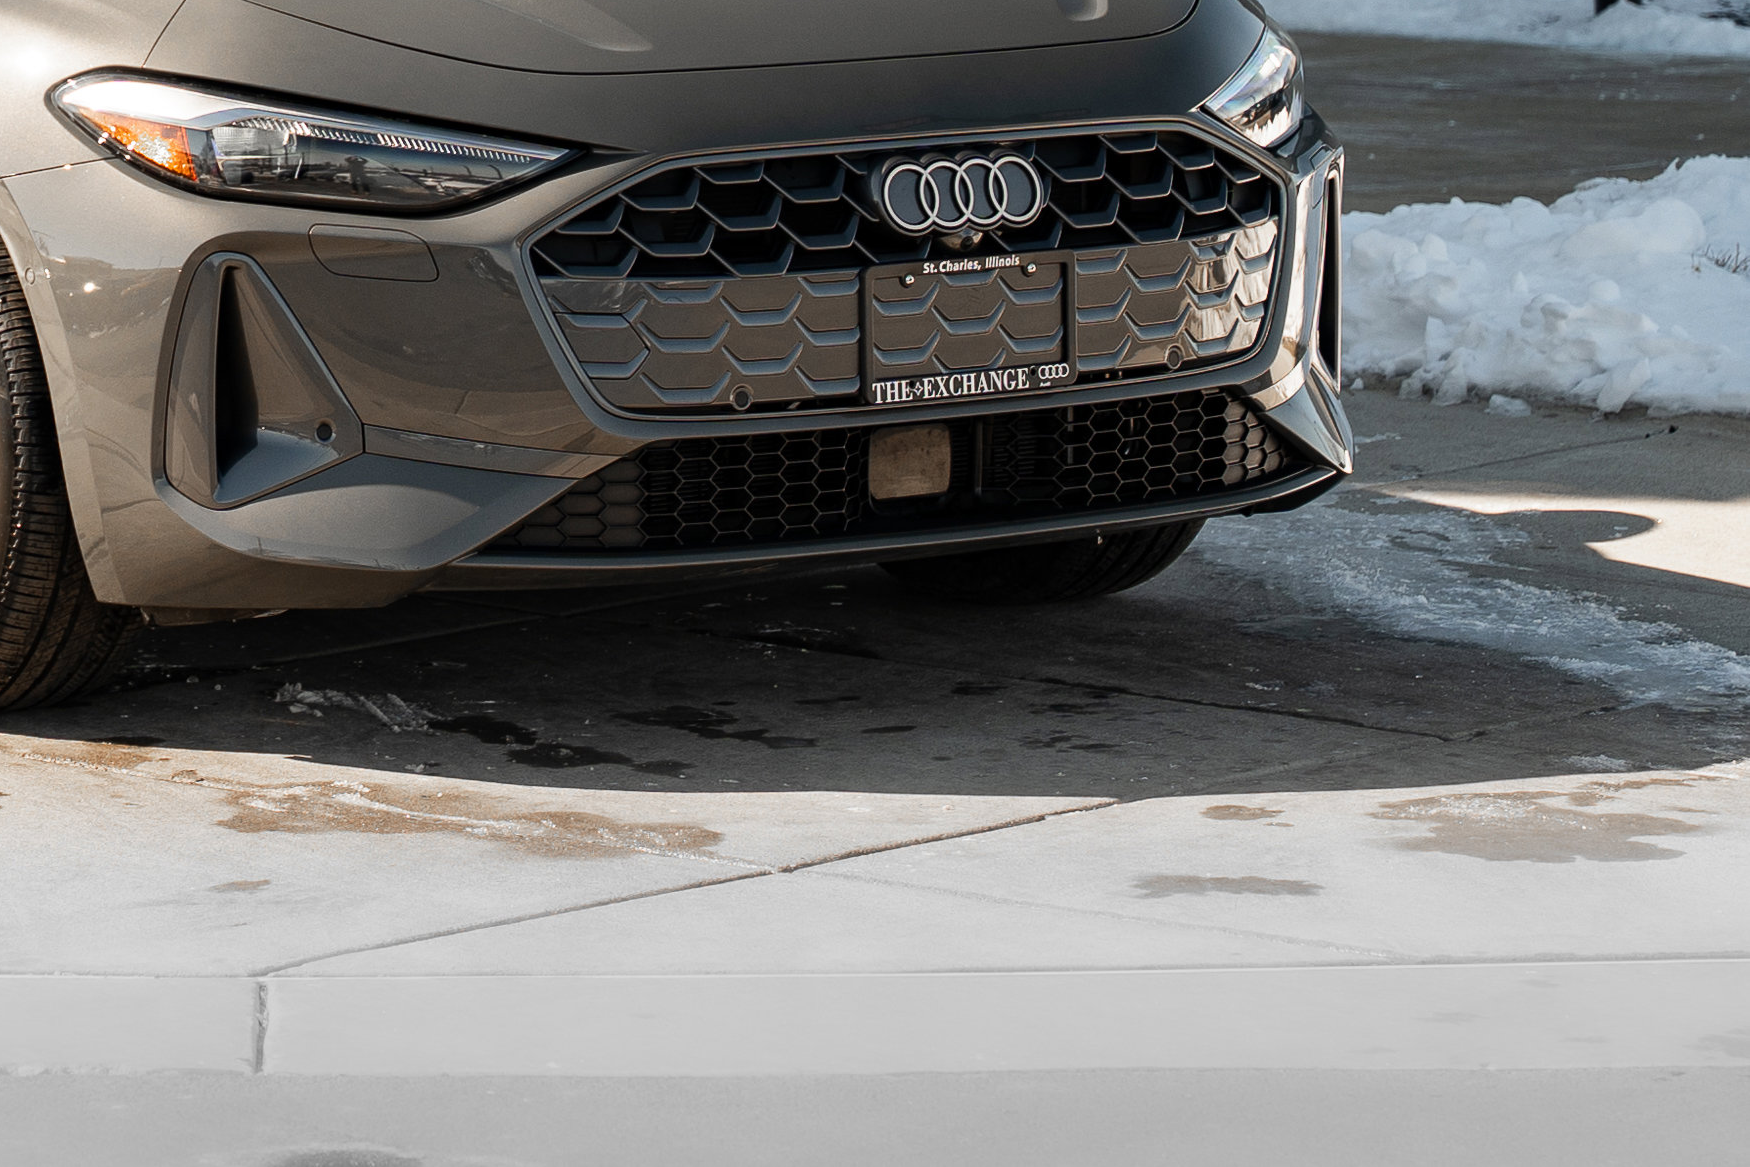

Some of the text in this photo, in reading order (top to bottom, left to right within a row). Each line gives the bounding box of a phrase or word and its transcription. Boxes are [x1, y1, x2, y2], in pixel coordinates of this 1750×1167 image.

[922, 254, 1020, 274] St. Charles, Illinois
[872, 368, 1030, 404] THE EXCHANGE
